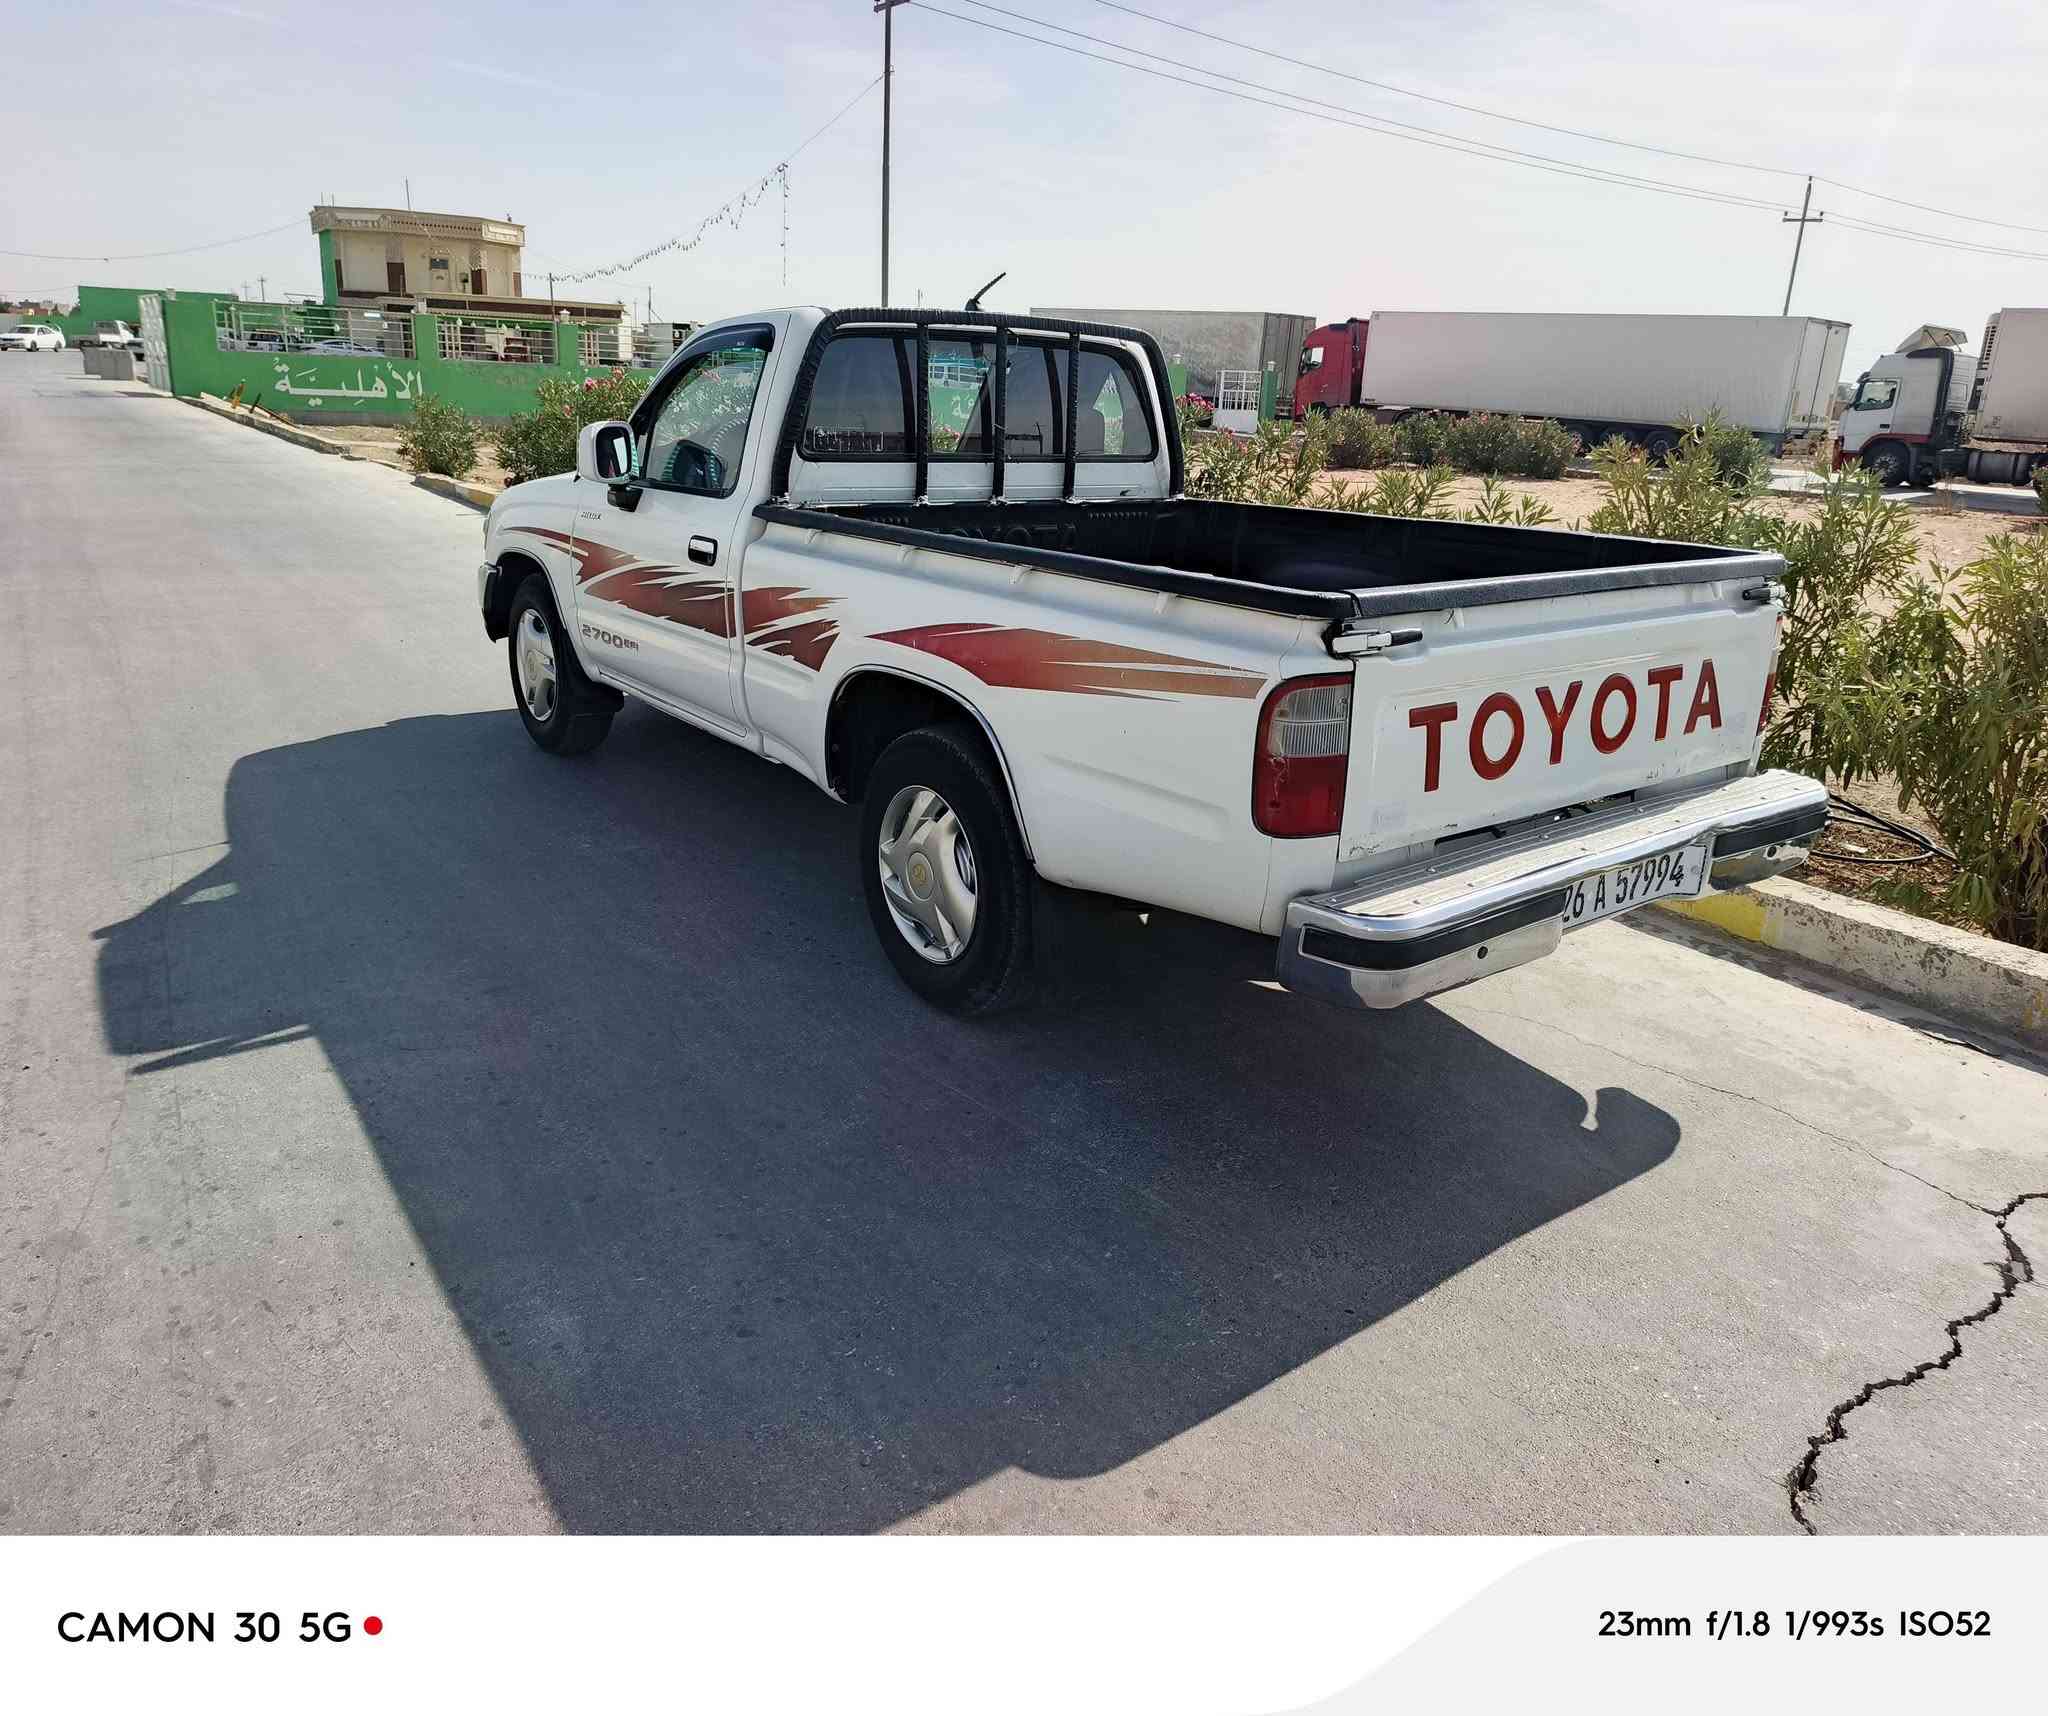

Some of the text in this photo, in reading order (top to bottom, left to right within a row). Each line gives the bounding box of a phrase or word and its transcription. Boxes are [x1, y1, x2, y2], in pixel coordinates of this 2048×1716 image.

[1409, 658, 1722, 792] TOYOTA
[1562, 852, 1684, 922] 26 A 57994
